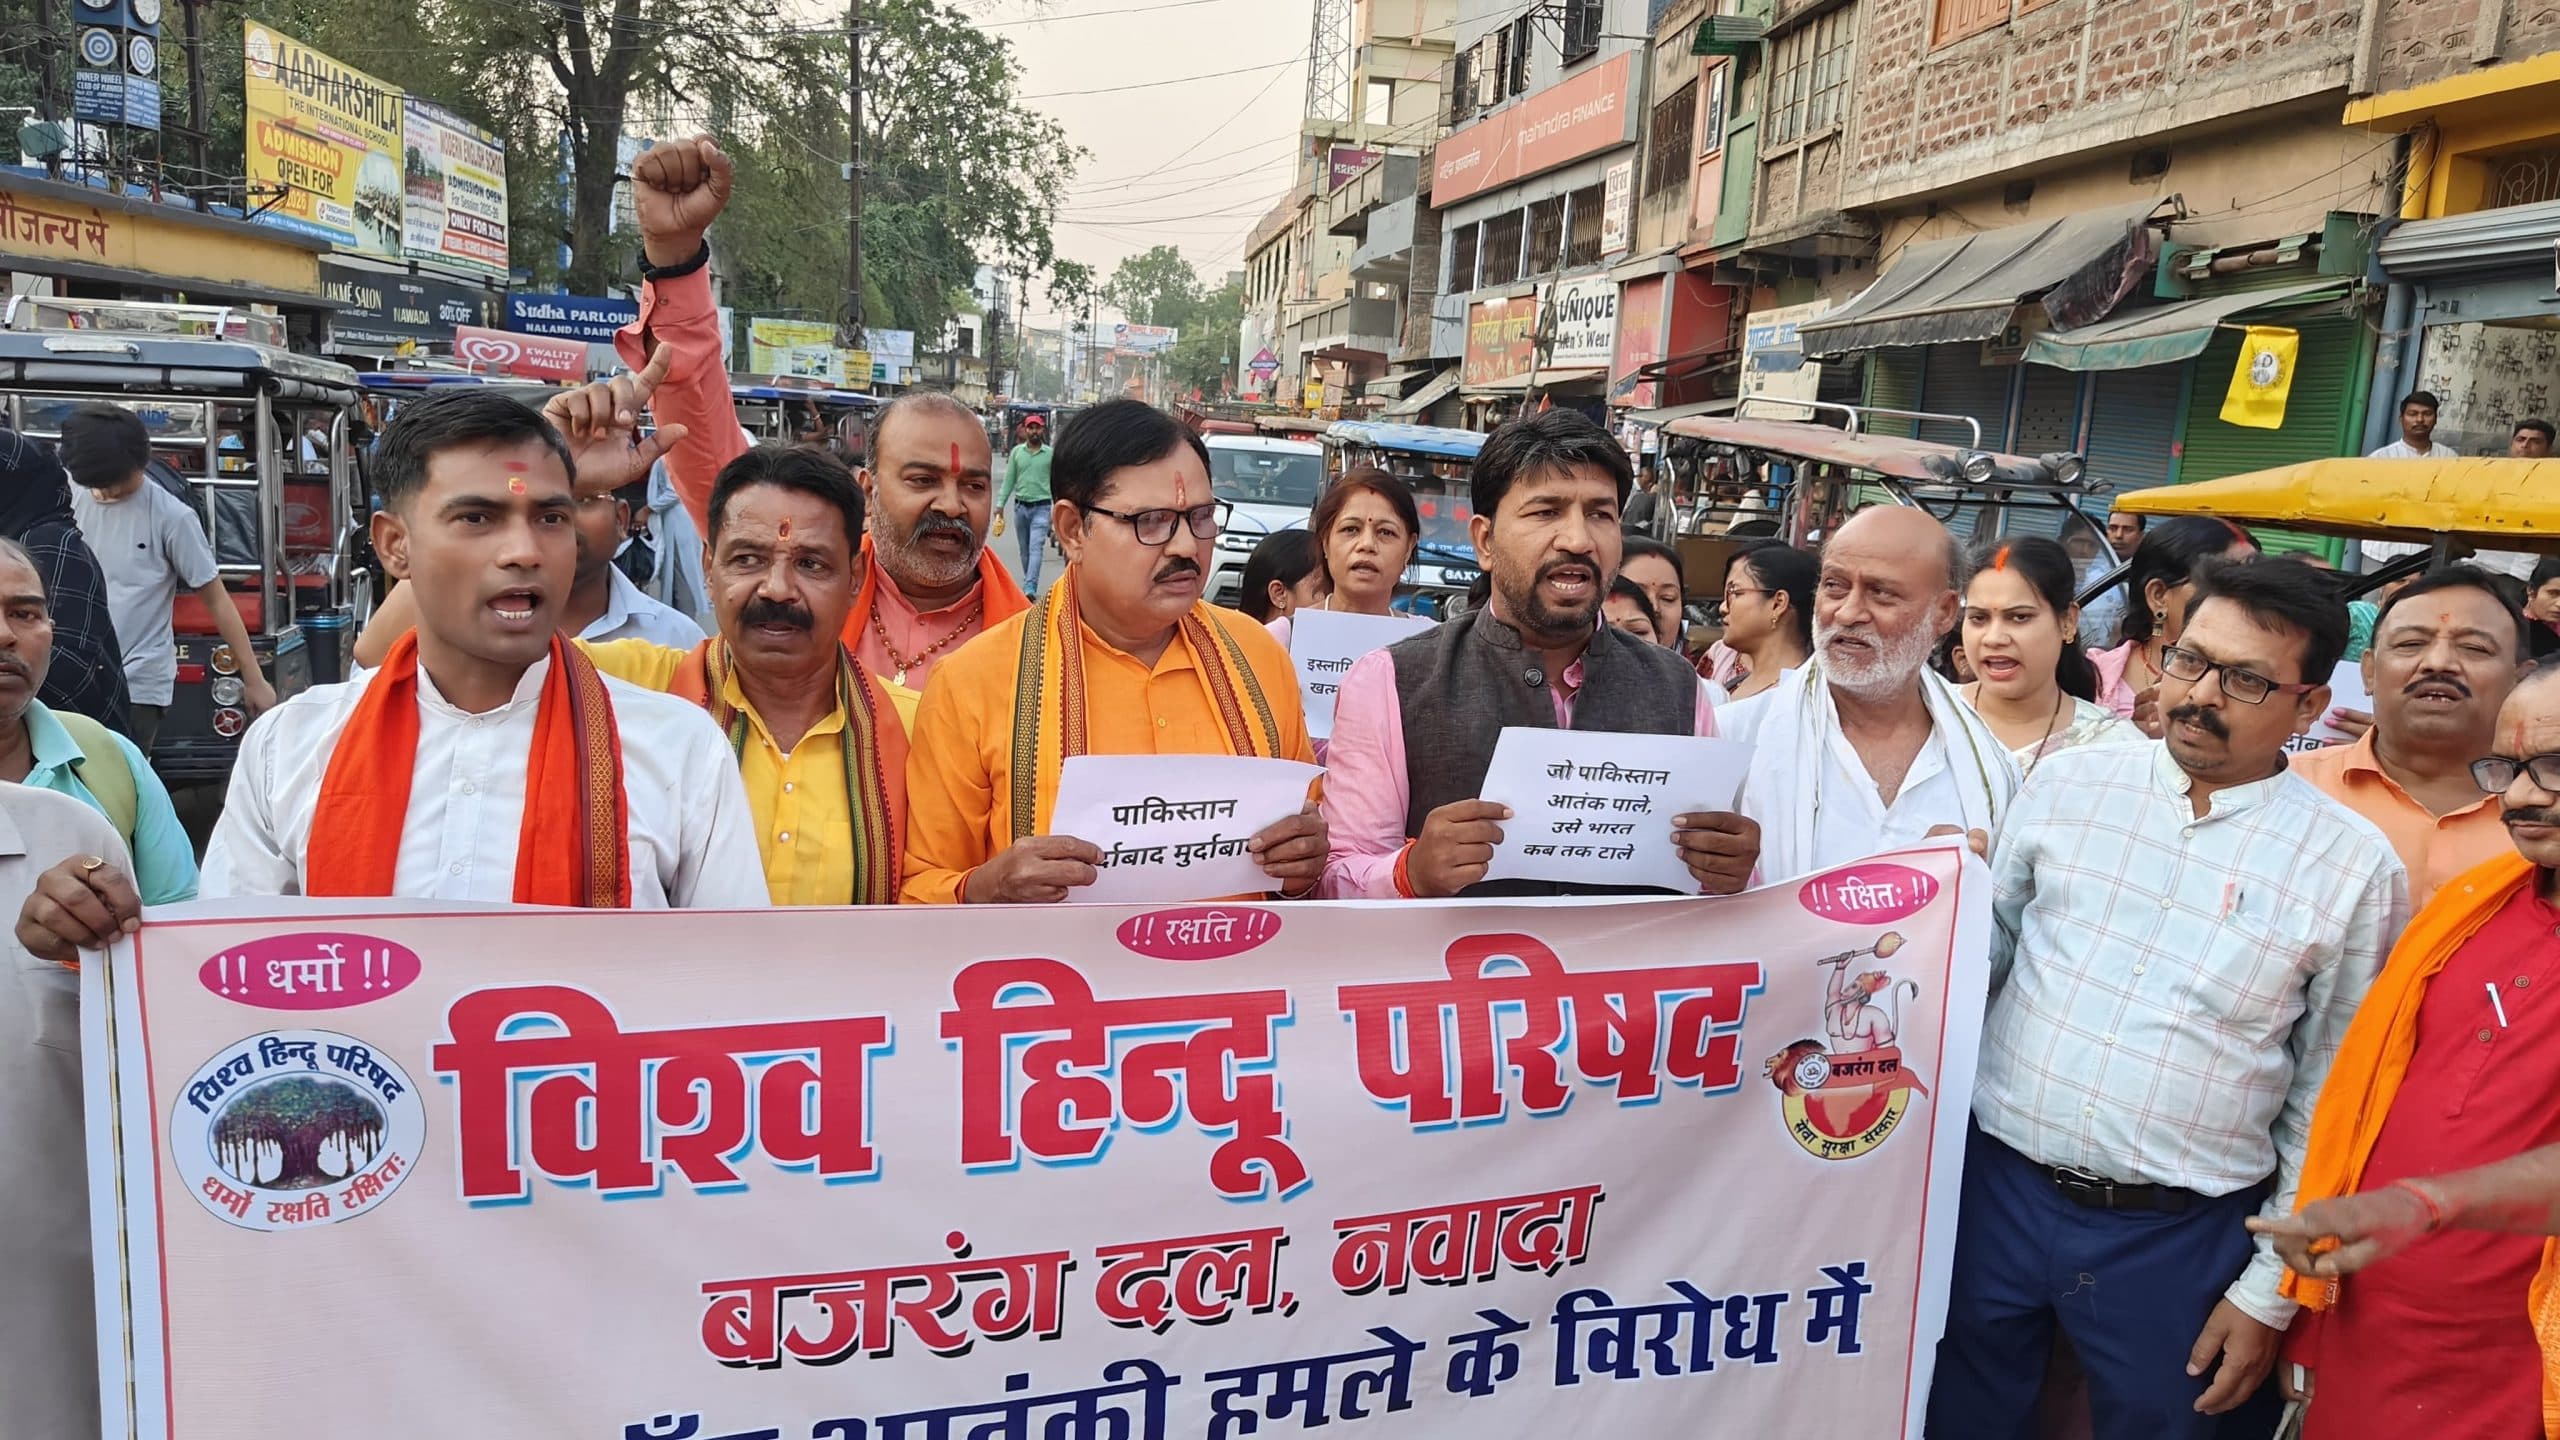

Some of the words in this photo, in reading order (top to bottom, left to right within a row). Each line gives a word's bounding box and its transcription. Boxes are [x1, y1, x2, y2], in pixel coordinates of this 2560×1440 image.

[76, 71, 99, 82] INNER
[101, 73, 122, 84] WHEEL
[276, 42, 398, 135] AADHARSHILA
[289, 96, 305, 113] THE
[306, 103, 362, 136] INTERNATIONAL
[364, 128, 389, 148] SCHOOL
[1516, 111, 1571, 147] mahindra
[1572, 92, 1616, 126] FINANCE
[263, 125, 340, 172] ADMISSION
[278, 158, 309, 187] OPEN
[312, 170, 334, 195] FOR
[449, 175, 485, 200] ADMISSION
[486, 188, 503, 206] OPEN
[84, 208, 110, 257] से
[451, 212, 471, 231] ONLY
[472, 219, 488, 237] FOR
[354, 285, 382, 310] SALON
[514, 300, 567, 320] Sudha
[570, 309, 638, 325] PARLOUR
[1559, 287, 1615, 328] UNIQUE
[393, 307, 431, 326] NAWADA
[439, 305, 454, 322] 30%
[456, 308, 472, 324] OFF
[525, 323, 581, 336] NALANDA
[525, 346, 580, 361] KWALITY
[1557, 328, 1583, 350] Men's
[1586, 329, 1611, 350] Wear
[530, 357, 573, 371] WALL'S
[1546, 760, 1574, 782] जो
[1578, 762, 1671, 786] पाकिस्तान
[1112, 796, 1238, 826] पाकिस्तान
[1548, 792, 1608, 811] आतंक
[1612, 794, 1653, 816] पाले,
[1552, 818, 1583, 835] उसे
[1588, 821, 1636, 835] भारत
[1174, 833, 1253, 868] मुर्दाबा
[1523, 843, 1557, 857] कब
[1560, 846, 1596, 859] तक
[1598, 843, 1635, 861] टाले
[1165, 911, 1237, 945] रक्षति
[266, 943, 346, 994] धर्मो
[187, 1052, 255, 1114] विश्व
[258, 1036, 320, 1071] हिन्दू
[326, 1043, 406, 1104] परिषद
[432, 984, 889, 1200] विश्व
[938, 956, 1306, 1195] हिन्दू
[1338, 932, 1762, 1124] परिषद
[1831, 1056, 1875, 1078] बजरंग
[1877, 1057, 1899, 1074] दल
[1793, 1118, 1819, 1145] सेवा
[1821, 1139, 1857, 1158] सुरक्षा
[1861, 1107, 1900, 1144] संस्कार
[202, 1176, 256, 1218] धर्मो
[266, 1191, 331, 1224] रक्षति
[701, 1231, 1076, 1367] बजरंग
[1095, 1226, 1299, 1334] दल,
[1330, 1184, 1605, 1293] नवादा
[1204, 1325, 1426, 1440] हमले
[1445, 1308, 1531, 1398] के
[1549, 1280, 1789, 1386] विरोध
[1807, 1261, 1872, 1354] में
